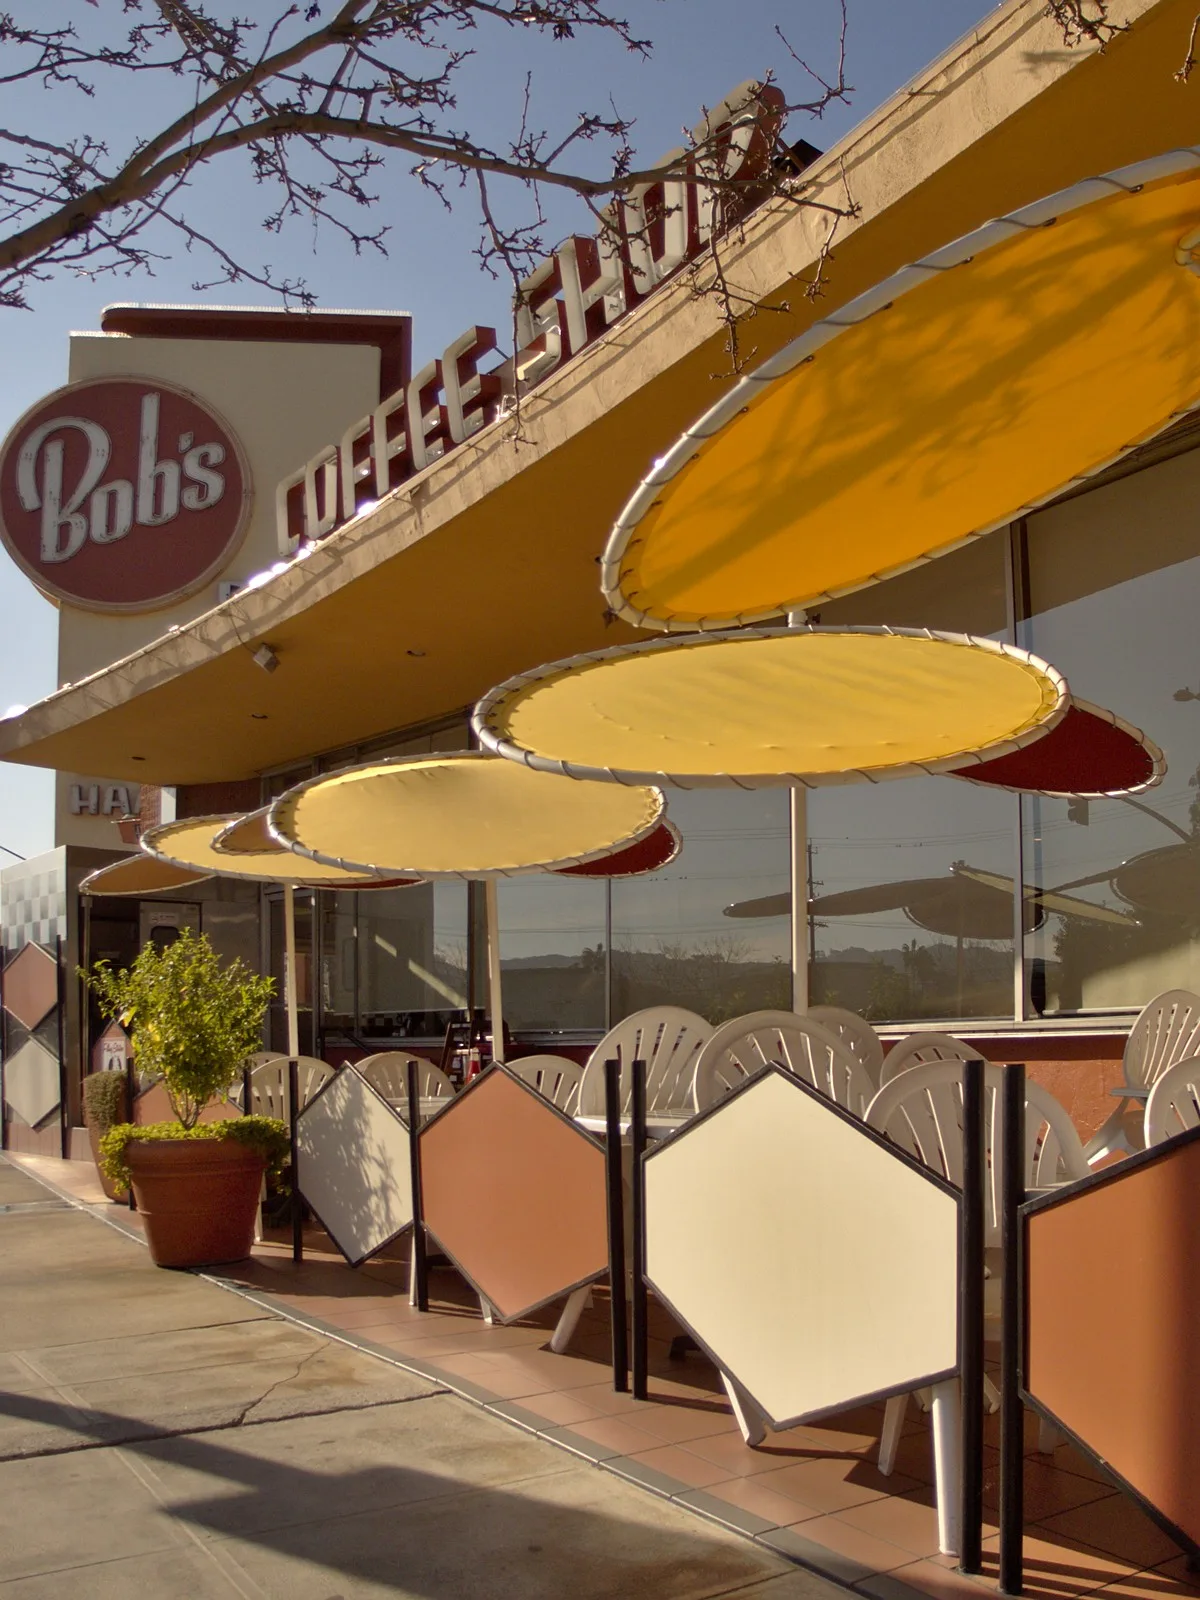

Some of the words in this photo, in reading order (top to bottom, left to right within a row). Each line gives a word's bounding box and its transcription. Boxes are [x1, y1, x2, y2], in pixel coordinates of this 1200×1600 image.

[276, 325, 500, 557] COFFEE
[511, 80, 783, 384] SHOP
[16, 392, 226, 563] Bob's
[70, 784, 140, 816] HA
